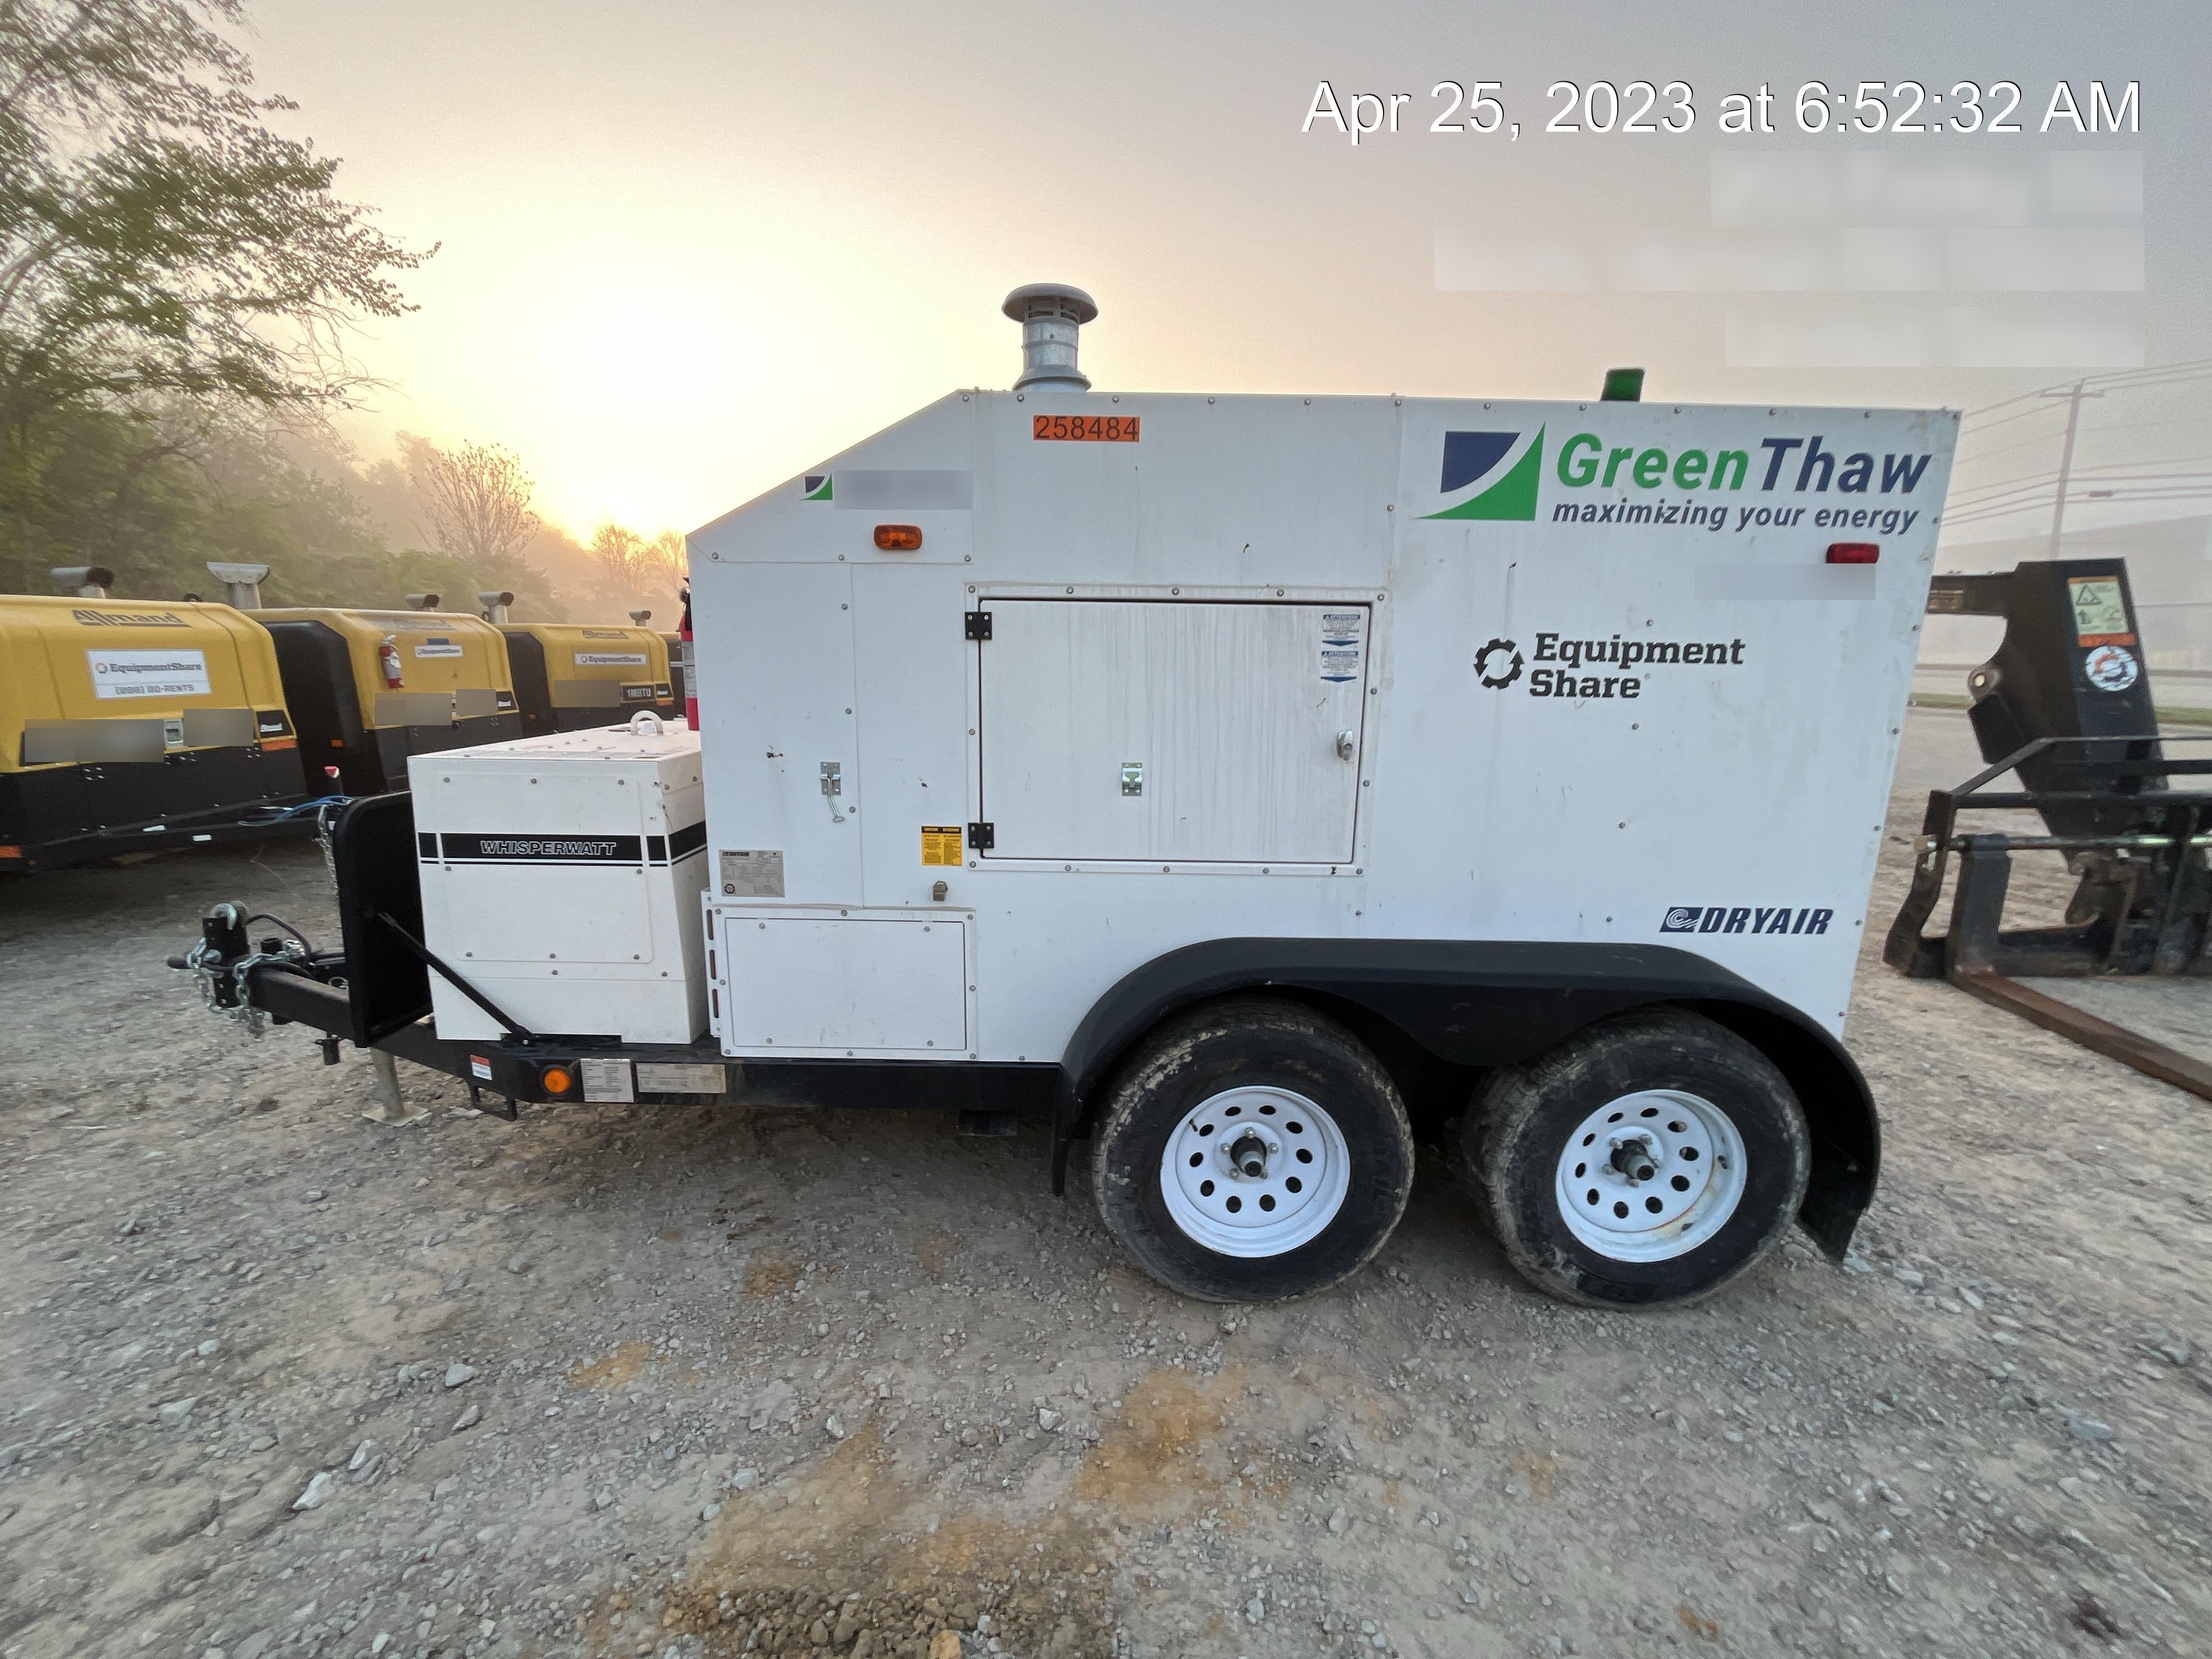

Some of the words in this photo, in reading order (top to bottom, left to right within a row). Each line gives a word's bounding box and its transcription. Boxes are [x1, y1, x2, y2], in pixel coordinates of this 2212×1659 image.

[1036, 415, 1138, 441] 258484
[1552, 496, 1729, 531] maximizing
[1735, 505, 1805, 532] your
[1814, 508, 1920, 536] energy
[1533, 633, 1746, 669] Equipment
[110, 663, 202, 673] EquipmentShare
[1529, 669, 1641, 698] Share
[480, 840, 617, 856] WHISPERWATT
[1697, 907, 1834, 935] DRYAIR
